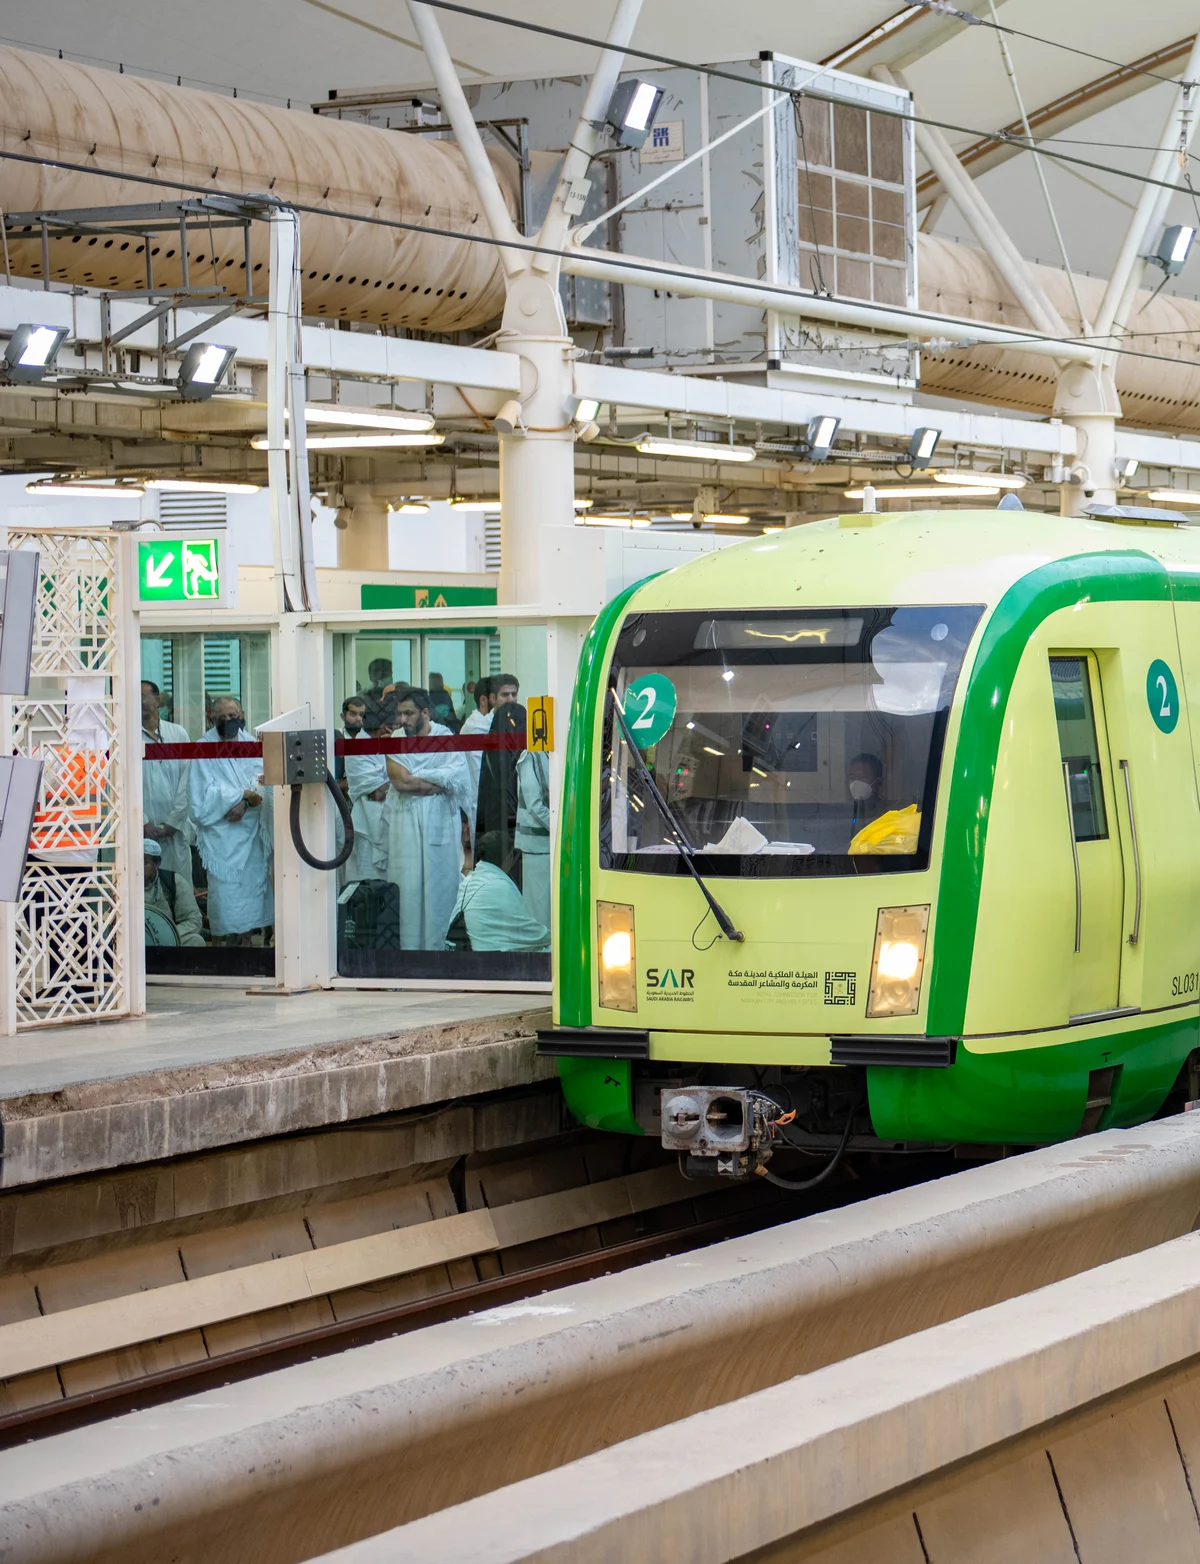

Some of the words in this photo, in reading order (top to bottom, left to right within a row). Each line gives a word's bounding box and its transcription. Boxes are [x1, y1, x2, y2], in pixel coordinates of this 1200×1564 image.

[1156, 675, 1171, 717] 2
[631, 686, 657, 730] 2
[646, 968, 694, 988] SAR
[728, 969, 743, 978] مكة
[744, 970, 767, 979] لمدينة
[768, 970, 793, 979] الملكية
[795, 971, 819, 979] الهيئة
[727, 979, 758, 987] المقدسة
[758, 979, 790, 989] والمشاعر
[791, 980, 818, 989] المكرمة
[1172, 972, 1199, 996] SL031
